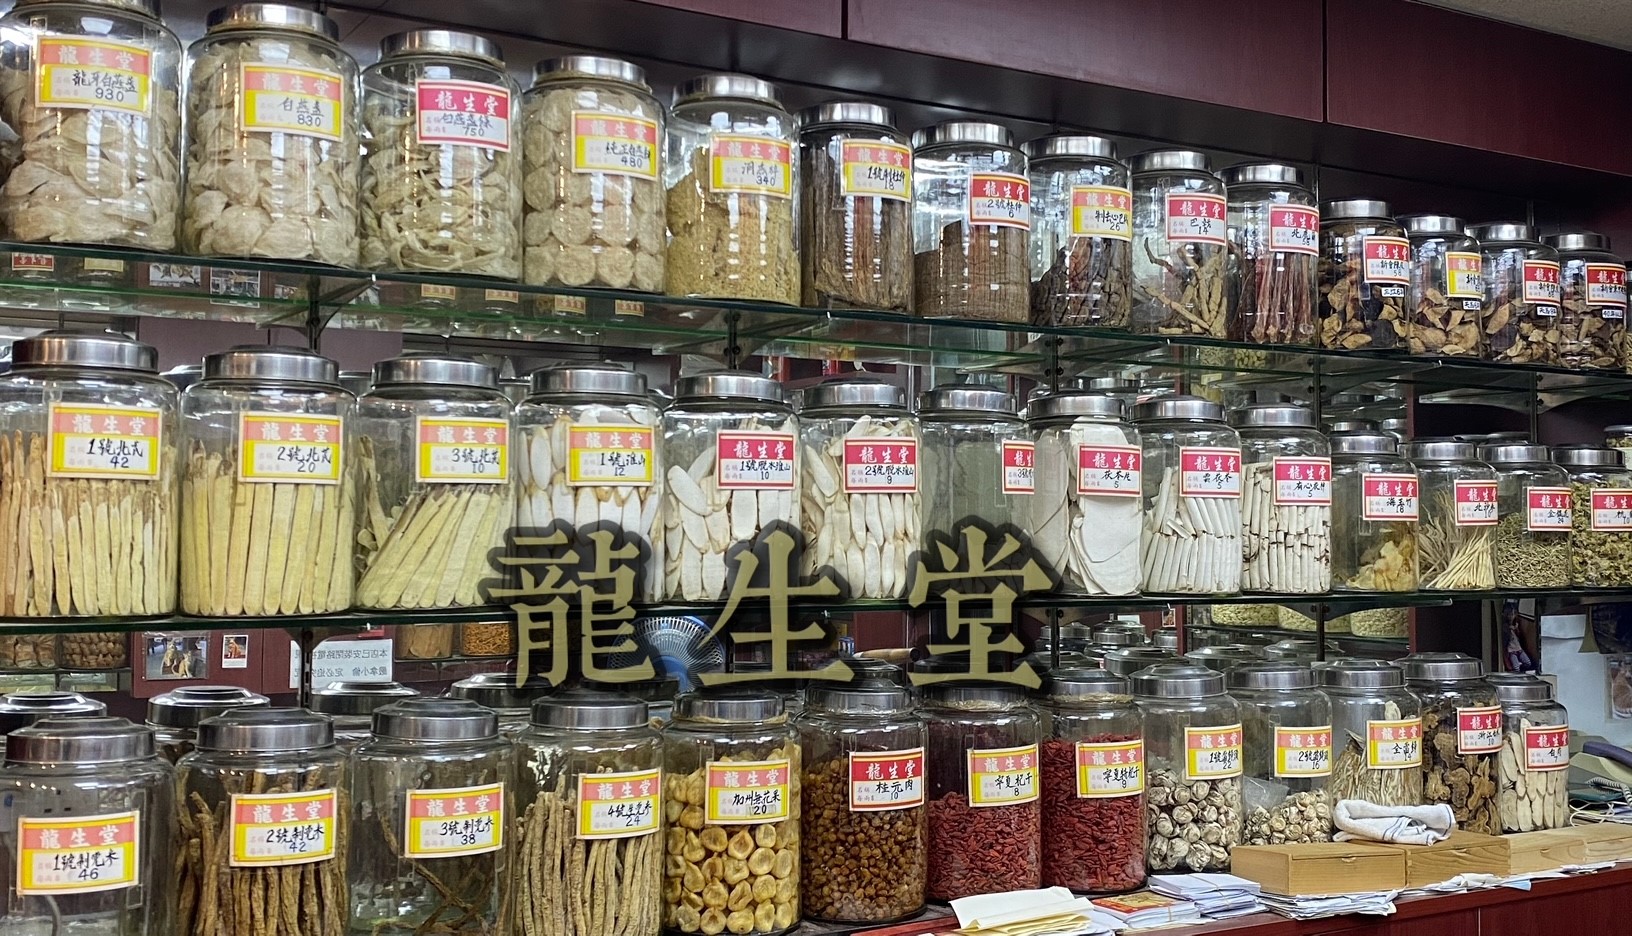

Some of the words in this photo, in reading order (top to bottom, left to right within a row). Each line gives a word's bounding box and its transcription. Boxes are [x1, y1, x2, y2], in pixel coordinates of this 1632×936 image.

[58, 45, 136, 71] 龍生堂
[262, 72, 331, 97] 龍生堂
[95, 87, 124, 102] 930
[435, 90, 500, 117] 龍生堂
[297, 113, 322, 128] 830
[462, 126, 485, 138] 750
[590, 119, 647, 142] 龍生堂
[727, 141, 781, 161] 龍生堂
[857, 148, 904, 167] 龍生堂
[621, 156, 643, 168] 480
[756, 175, 776, 186] 340
[884, 180, 895, 191] 18
[983, 182, 1026, 202] 龍生堂
[1085, 194, 1127, 210] 龍生堂
[1180, 201, 1221, 219] 龍生堂
[1008, 209, 1015, 219] 6
[1282, 212, 1316, 231] 龍生堂
[1109, 222, 1121, 232] 26
[1198, 226, 1209, 235] 14
[1376, 244, 1408, 261] 龍生堂
[72, 415, 146, 437] 龍生堂
[262, 422, 331, 444] 龍生堂
[437, 425, 498, 445] 龍生堂
[584, 432, 644, 450] 龍生堂
[86, 438, 144, 458] 1號北芪
[277, 445, 332, 464] 2號北芪
[451, 447, 500, 465] 3號北芪
[733, 440, 787, 460] 龍生堂
[859, 446, 910, 465] 龍生堂
[109, 456, 130, 469] 42
[297, 461, 316, 473] 20
[471, 462, 485, 474] 10
[1092, 453, 1136, 471] 龍生堂
[1193, 455, 1237, 472] 龍生堂
[613, 466, 626, 478] 12
[760, 470, 770, 481] 10
[885, 475, 893, 485] 9
[1287, 465, 1327, 482] 龍生堂
[1113, 480, 1120, 489] 5
[1216, 481, 1222, 490] 5
[1376, 481, 1416, 497] 龍生堂
[1307, 489, 1314, 498] 5
[1603, 496, 1632, 508] 龍生
[1200, 733, 1238, 749] 龍生堂
[1289, 733, 1329, 748] 龍生堂
[1381, 726, 1418, 740] 龍生堂
[984, 754, 1031, 773] 龍生堂
[1092, 748, 1137, 766] 龍生堂
[865, 759, 916, 781] 龍生堂
[1222, 761, 1232, 770] 22
[723, 768, 780, 788] 龍生堂
[1121, 779, 1127, 789] 9
[597, 780, 651, 801] 龍生堂
[875, 780, 913, 794] 桂元肉
[1014, 788, 1020, 797] 8
[732, 789, 781, 806] 加州無花果
[890, 792, 899, 801] 10
[253, 801, 322, 824] 龍生堂
[426, 795, 491, 817] 龍生堂
[753, 804, 767, 815] 20
[625, 815, 641, 827] 24
[39, 825, 119, 850] 龍生堂
[460, 834, 476, 846] 38
[288, 841, 307, 853] 42
[78, 868, 99, 880] 46
